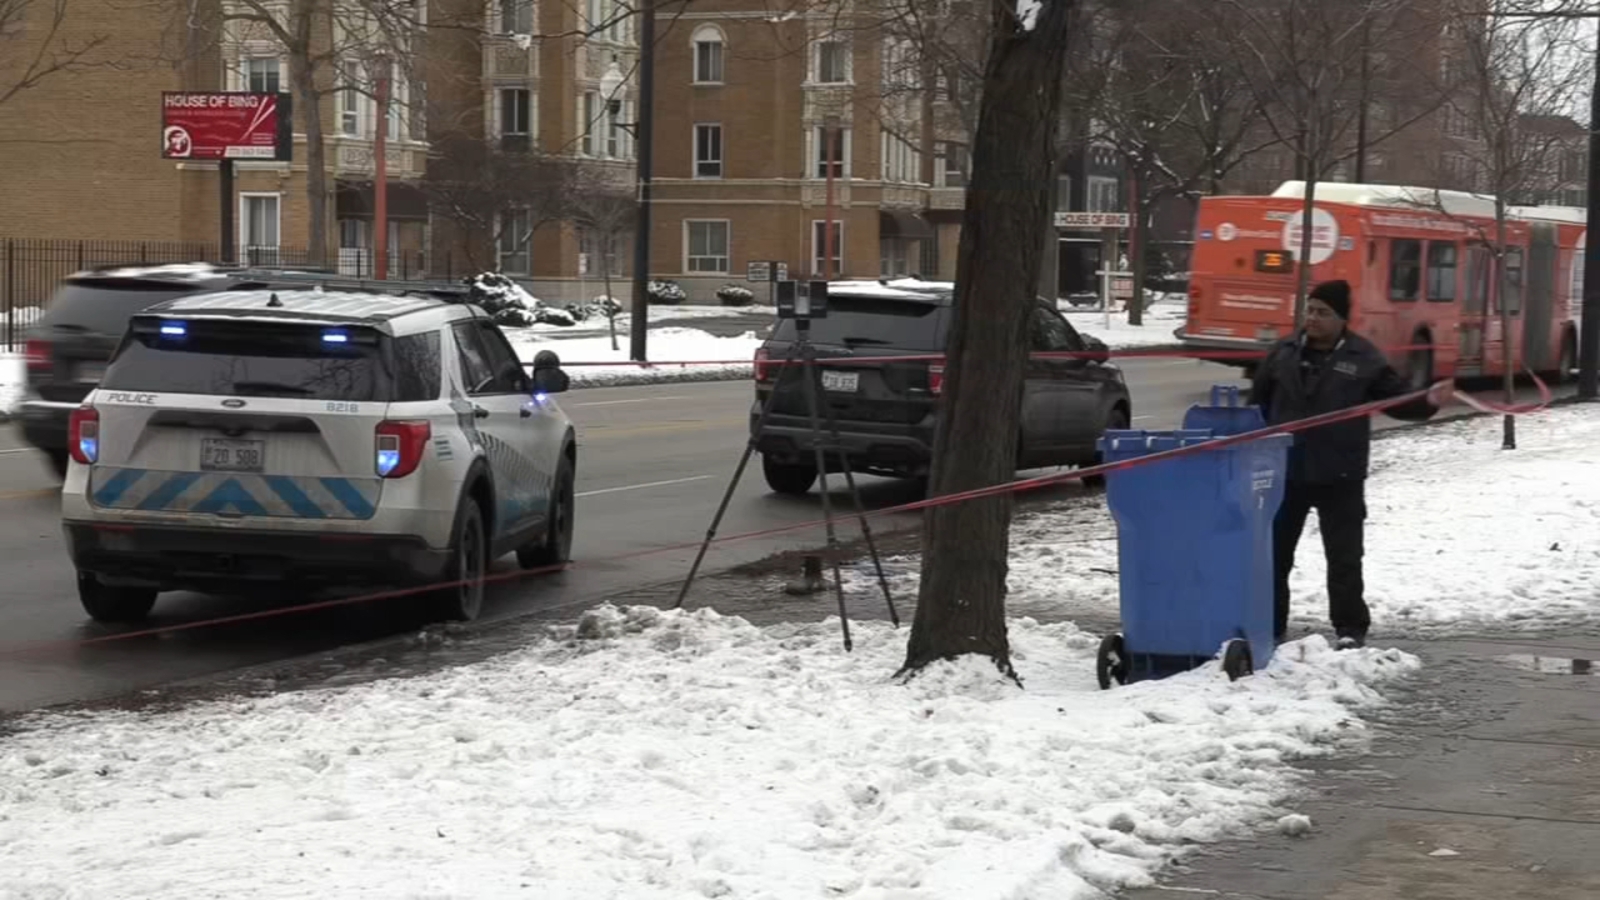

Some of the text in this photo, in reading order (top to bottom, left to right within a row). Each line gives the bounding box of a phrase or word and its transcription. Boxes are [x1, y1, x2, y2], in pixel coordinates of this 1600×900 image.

[164, 95, 259, 108] HOUSE OF BING
[1059, 214, 1090, 225] HOUSE
[1091, 214, 1104, 225] OF
[108, 392, 159, 405] POLICE
[326, 402, 359, 414] 8218
